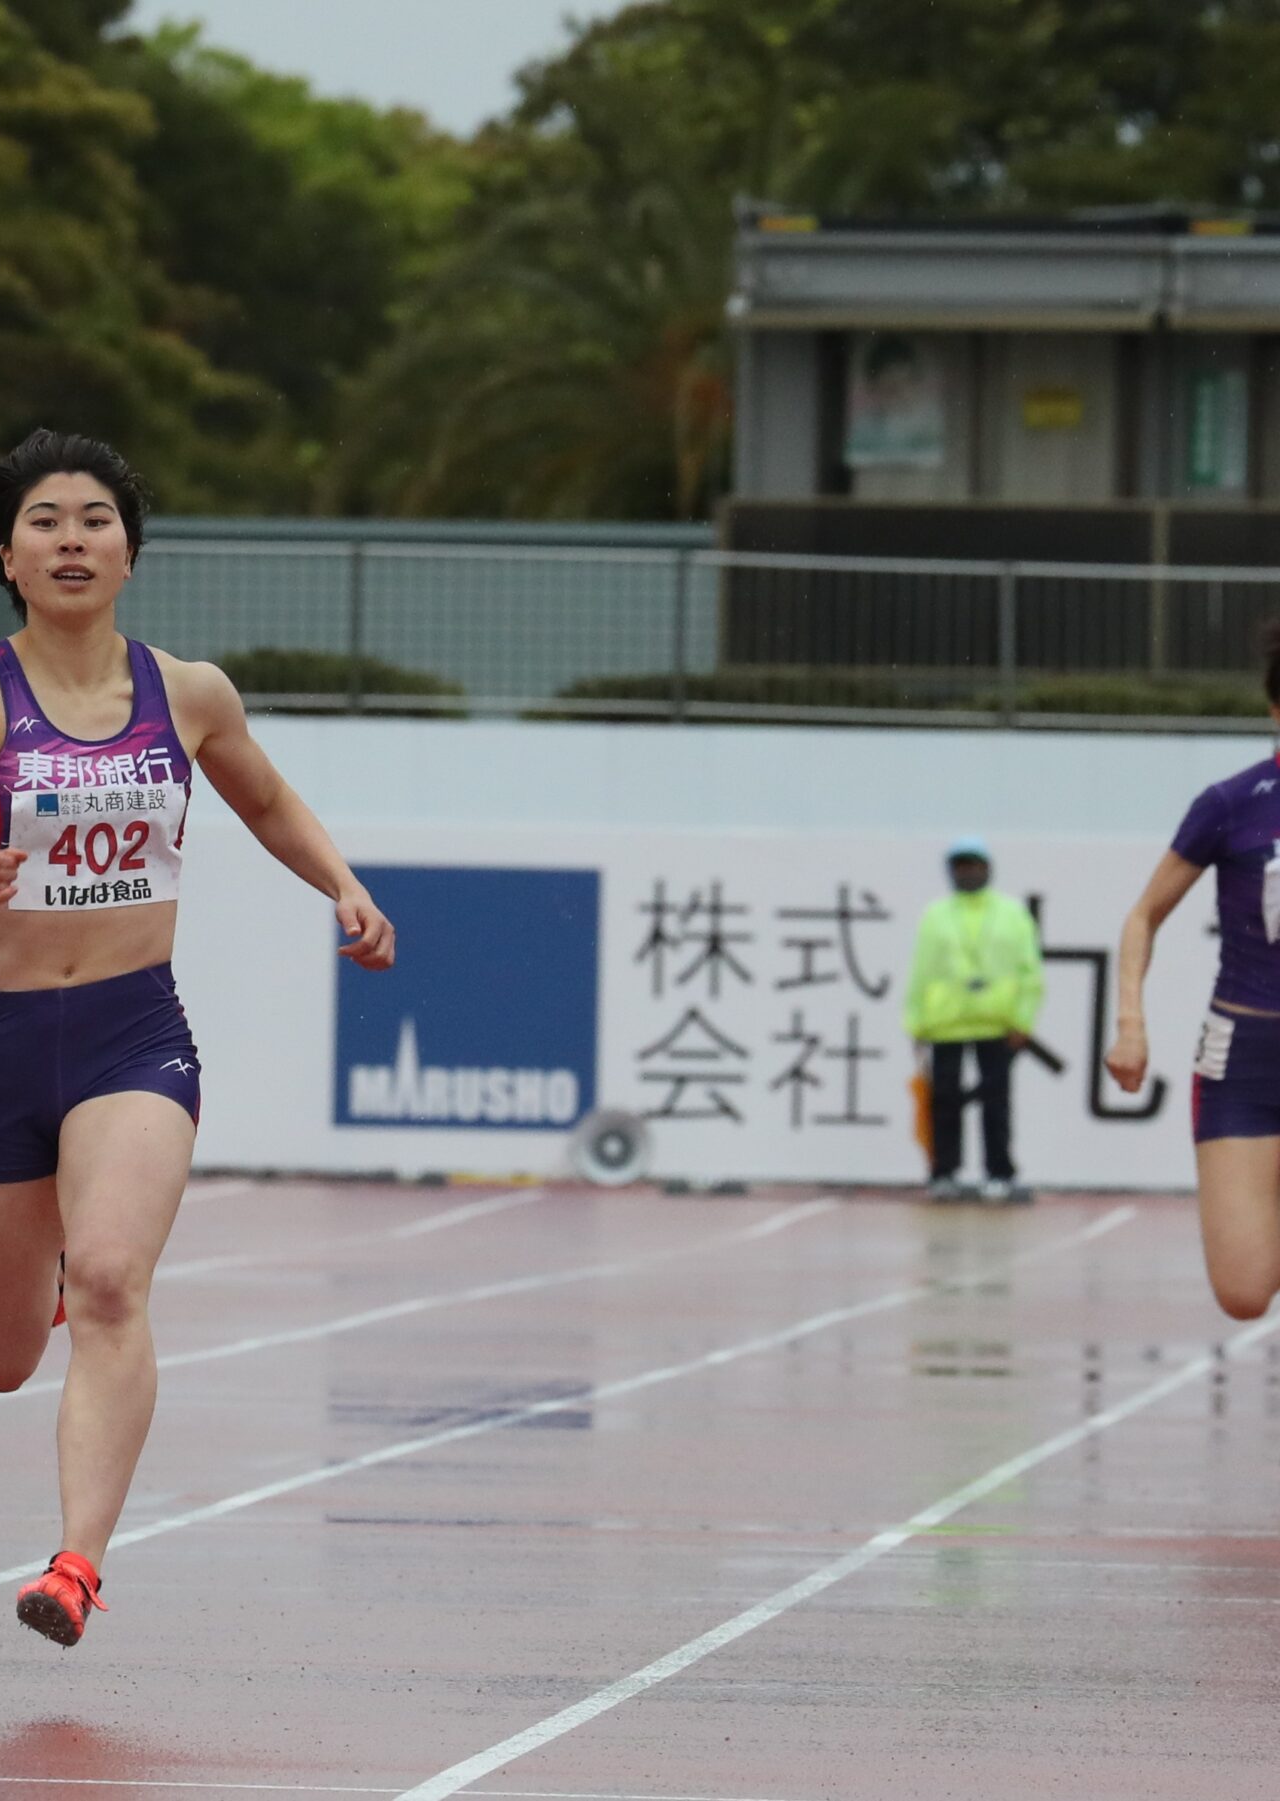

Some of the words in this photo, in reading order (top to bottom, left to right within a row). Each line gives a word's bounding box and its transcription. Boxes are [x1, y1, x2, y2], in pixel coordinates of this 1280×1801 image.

[14, 748, 174, 789] 東邦銀行
[84, 788, 167, 813] 丸商建設
[48, 819, 150, 877] 402
[45, 877, 152, 907] いなば食品
[633, 878, 892, 1000] 株式
[349, 1014, 580, 1123] MARUSHO
[635, 1003, 888, 1131] 会社
